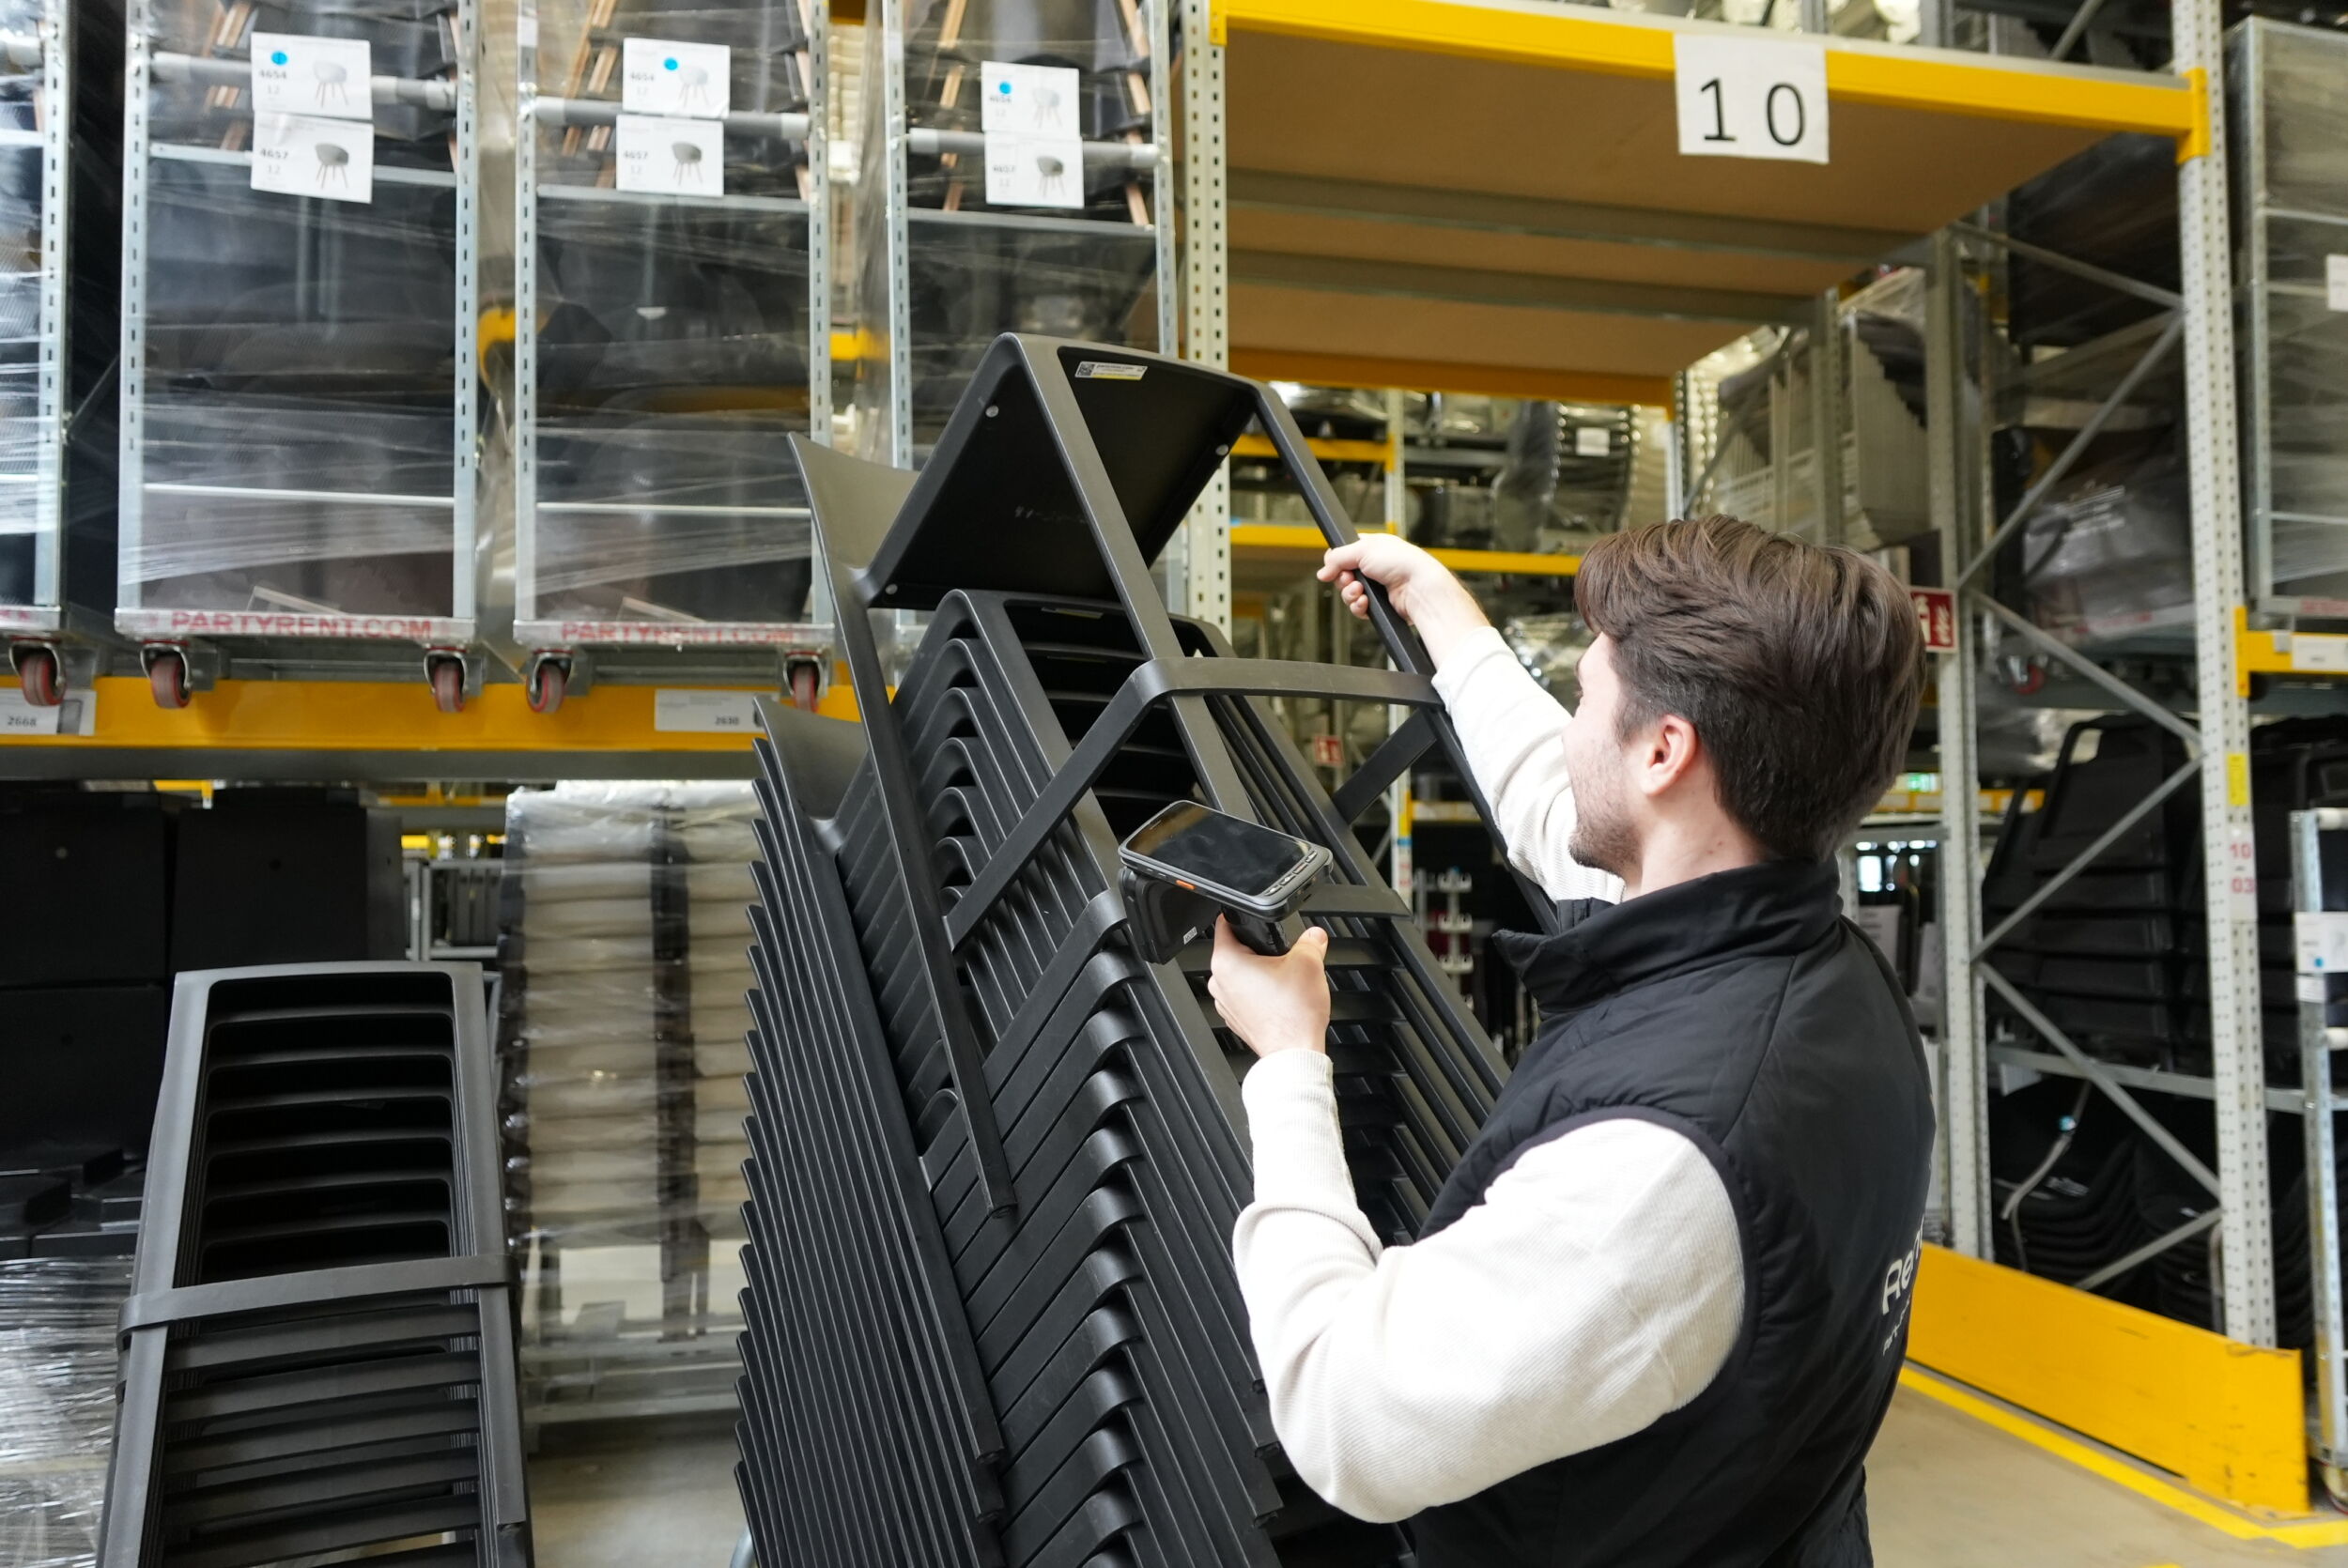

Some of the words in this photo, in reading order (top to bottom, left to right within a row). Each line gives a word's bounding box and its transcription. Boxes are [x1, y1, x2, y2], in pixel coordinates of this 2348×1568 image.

[171, 610, 432, 639] PARTYRENT.COM
[2230, 843, 2252, 859] 10
[2232, 877, 2256, 894] 03
